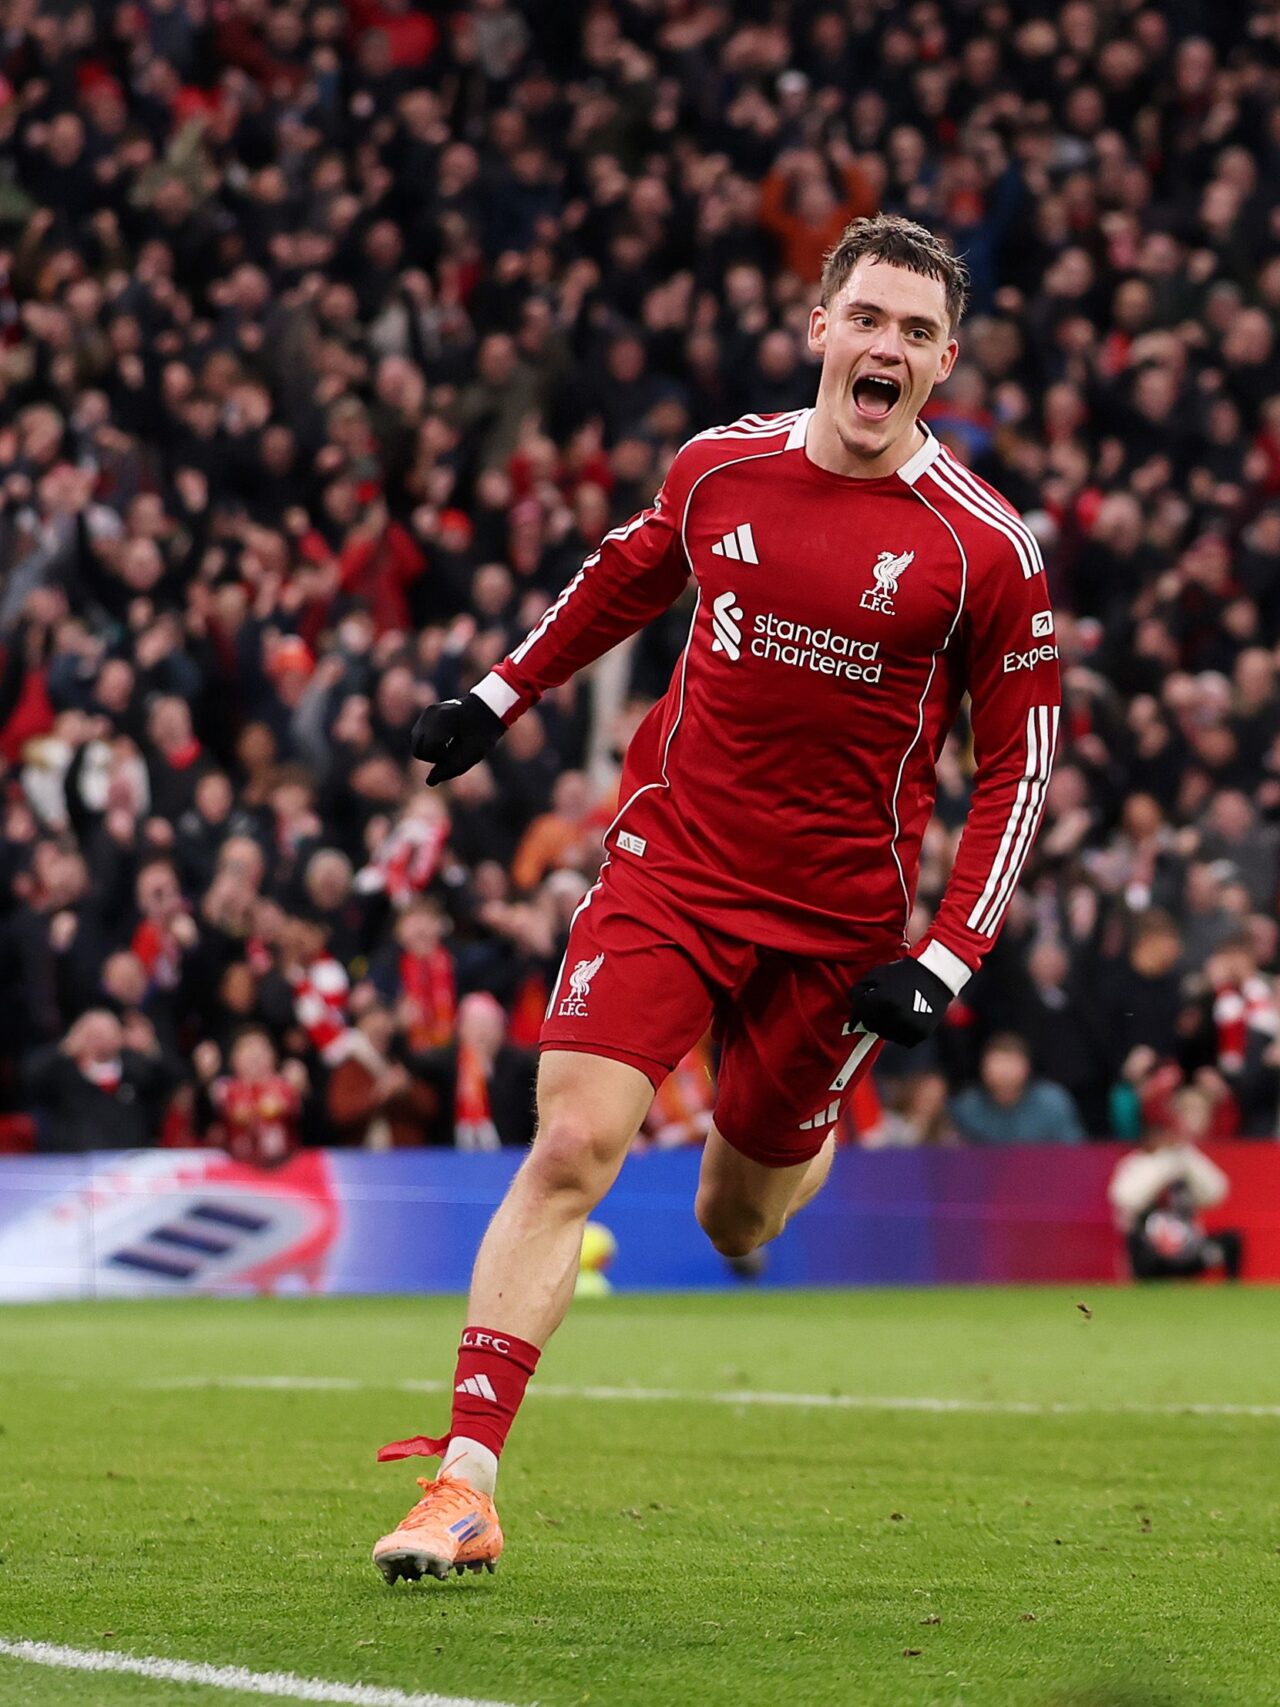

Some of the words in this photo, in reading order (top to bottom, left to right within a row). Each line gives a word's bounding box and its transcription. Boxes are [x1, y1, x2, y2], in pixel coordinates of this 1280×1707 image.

[751, 636, 882, 683] chartered
[753, 612, 880, 661] standard
[462, 1332, 510, 1354] LFC
